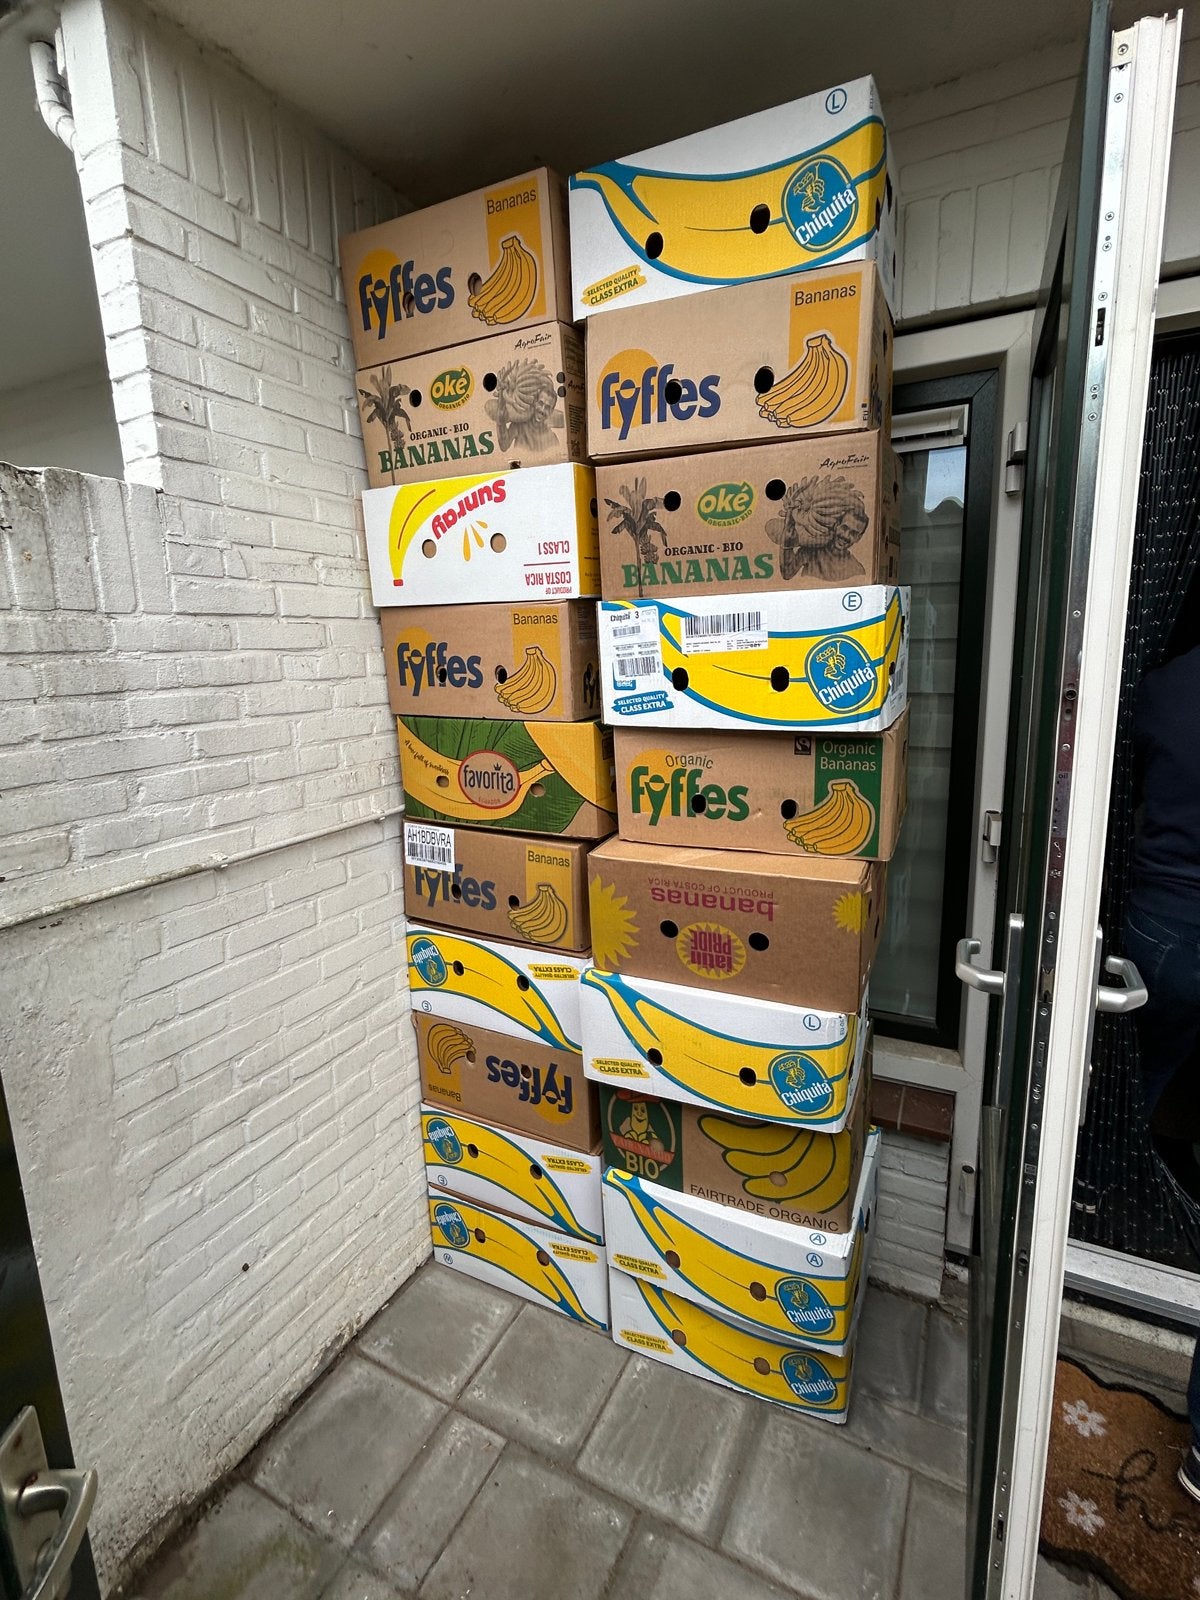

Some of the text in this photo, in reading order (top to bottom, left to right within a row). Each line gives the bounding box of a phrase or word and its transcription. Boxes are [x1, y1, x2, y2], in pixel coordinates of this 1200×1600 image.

[829, 93, 840, 109] L
[486, 188, 537, 216] Bananas
[795, 188, 858, 247] Chiquita
[586, 267, 639, 297] SELECTED QUALITY
[359, 260, 455, 340] fyffes
[590, 278, 639, 306] CLASS EXTRA
[794, 284, 857, 306] Bananas
[514, 333, 552, 351] AgroFair
[431, 370, 467, 399] oké
[601, 364, 721, 441] fyffes
[409, 426, 448, 441] ORGANIC
[453, 422, 469, 434] BIO
[378, 431, 495, 473] BANANAS
[819, 454, 870, 470] AgroFair
[700, 486, 750, 513] oké
[431, 479, 507, 540] Sunray
[542, 540, 570, 555] CLASS
[664, 543, 715, 556] ORGANIC
[722, 541, 743, 552] BIO
[524, 572, 544, 586] RICA
[545, 571, 571, 585] COSTA
[622, 553, 774, 588] BANANAS
[847, 594, 857, 608] E
[513, 612, 558, 626] Bananas
[634, 610, 640, 619] 3
[396, 641, 484, 697] fyffes
[818, 665, 875, 706] Chiquita
[617, 693, 665, 706] SELECTED QUALITY
[620, 700, 667, 714] CLASS EXTRA
[822, 740, 877, 758] Organic
[665, 753, 714, 769] Organic
[820, 756, 877, 772] Bananas
[463, 764, 515, 794] favorita
[630, 765, 750, 826] fyffes
[527, 850, 570, 868] Bananas
[648, 876, 774, 899] PRODUCT OF COSTA RICA
[650, 886, 775, 922] bananas
[690, 930, 732, 955] PRIDE
[412, 945, 439, 964] Chiquita
[690, 950, 733, 973] latin
[596, 1058, 641, 1069] SELECTED QUALITY
[599, 1065, 643, 1076] CLASS EXTRA
[428, 1083, 462, 1102] Bananas
[485, 1055, 573, 1114] fyffes
[780, 1079, 832, 1107] Chiquita
[428, 1126, 455, 1143] Chiquita
[546, 1157, 585, 1168] CLASS EXTRA
[625, 1151, 659, 1180] BIO
[690, 1183, 840, 1232] FAIRTRADE ORGANIC
[436, 1211, 462, 1225] Chiquita
[551, 1244, 589, 1256] CLASS EXTRA
[616, 1253, 658, 1268] SELECTED QUALITY
[619, 1260, 659, 1275] CLASS EXTRA
[786, 1306, 834, 1325] Chiquita
[623, 1330, 666, 1345] SELECTED QUALITY
[627, 1336, 667, 1351] CLASS EXTRA
[790, 1380, 837, 1396] Chiquita
